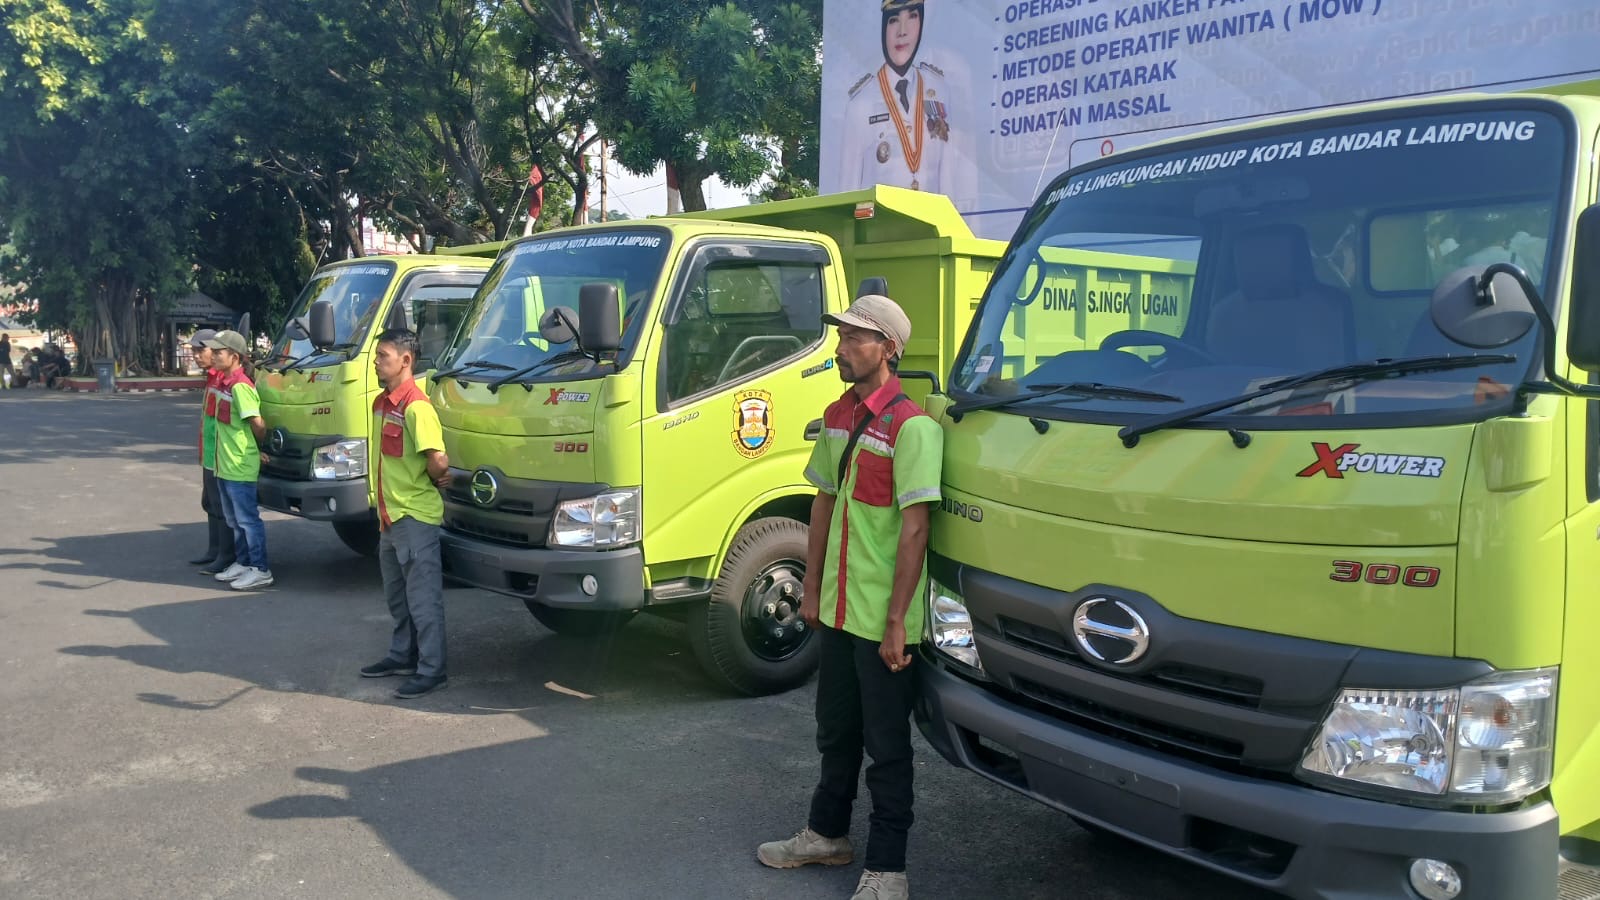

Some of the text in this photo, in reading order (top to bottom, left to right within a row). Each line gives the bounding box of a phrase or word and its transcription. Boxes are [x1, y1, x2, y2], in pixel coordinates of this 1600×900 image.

[1002, 49, 1076, 81] METODE
[1081, 28, 1180, 65] OPERATIF
[1186, 9, 1275, 45] WANITA
[1299, 0, 1364, 23] MOW
[1003, 13, 1108, 53] SCREENING
[1114, 0, 1200, 29] KANKER
[1001, 78, 1078, 109] OPERASI
[1084, 60, 1177, 94] KATARAK
[1000, 107, 1081, 136] SUNATAN
[1088, 93, 1171, 124] MASSAL
[1046, 121, 1536, 206] DINAS LINGKUNGAN HIDUP KOTA BANDAR LAMPUNG
[617, 236, 661, 248] LAMPUNG
[1043, 287, 1078, 311] DINA
[554, 442, 588, 453] 300
[1329, 560, 1441, 588] 300
